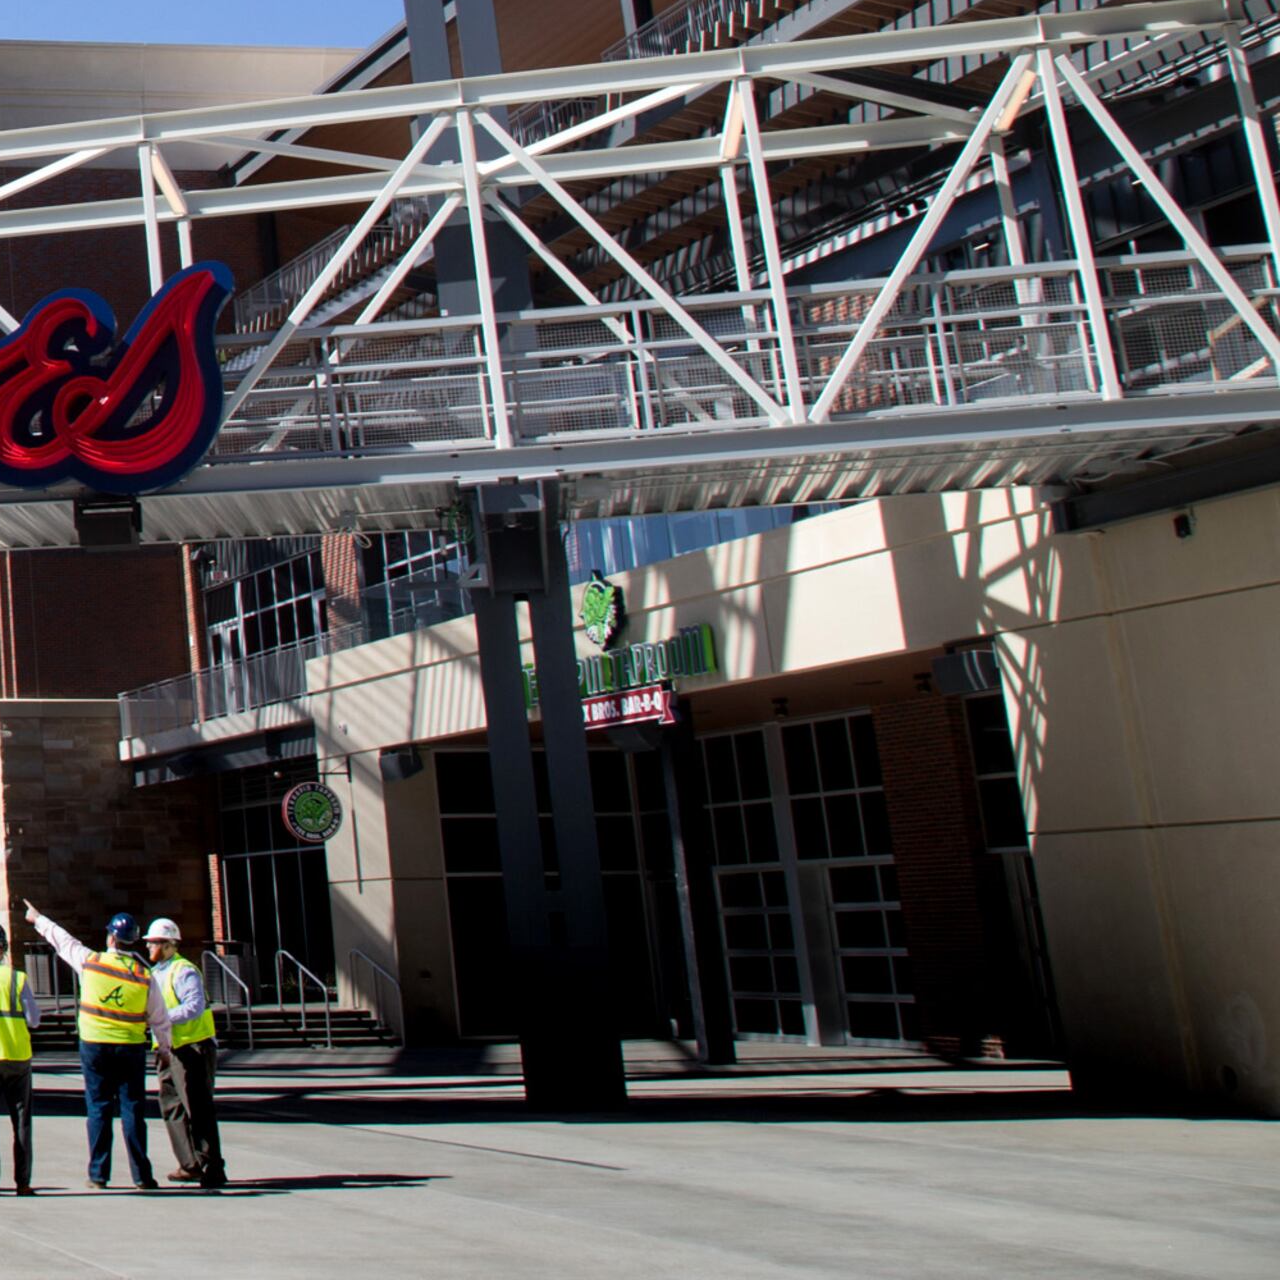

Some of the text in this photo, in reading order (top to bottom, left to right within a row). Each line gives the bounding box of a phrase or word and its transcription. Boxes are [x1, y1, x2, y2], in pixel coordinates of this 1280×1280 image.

[606, 623, 717, 691] TAPROOM
[591, 699, 620, 721] BROS.
[622, 692, 662, 716] BAR-B-Q
